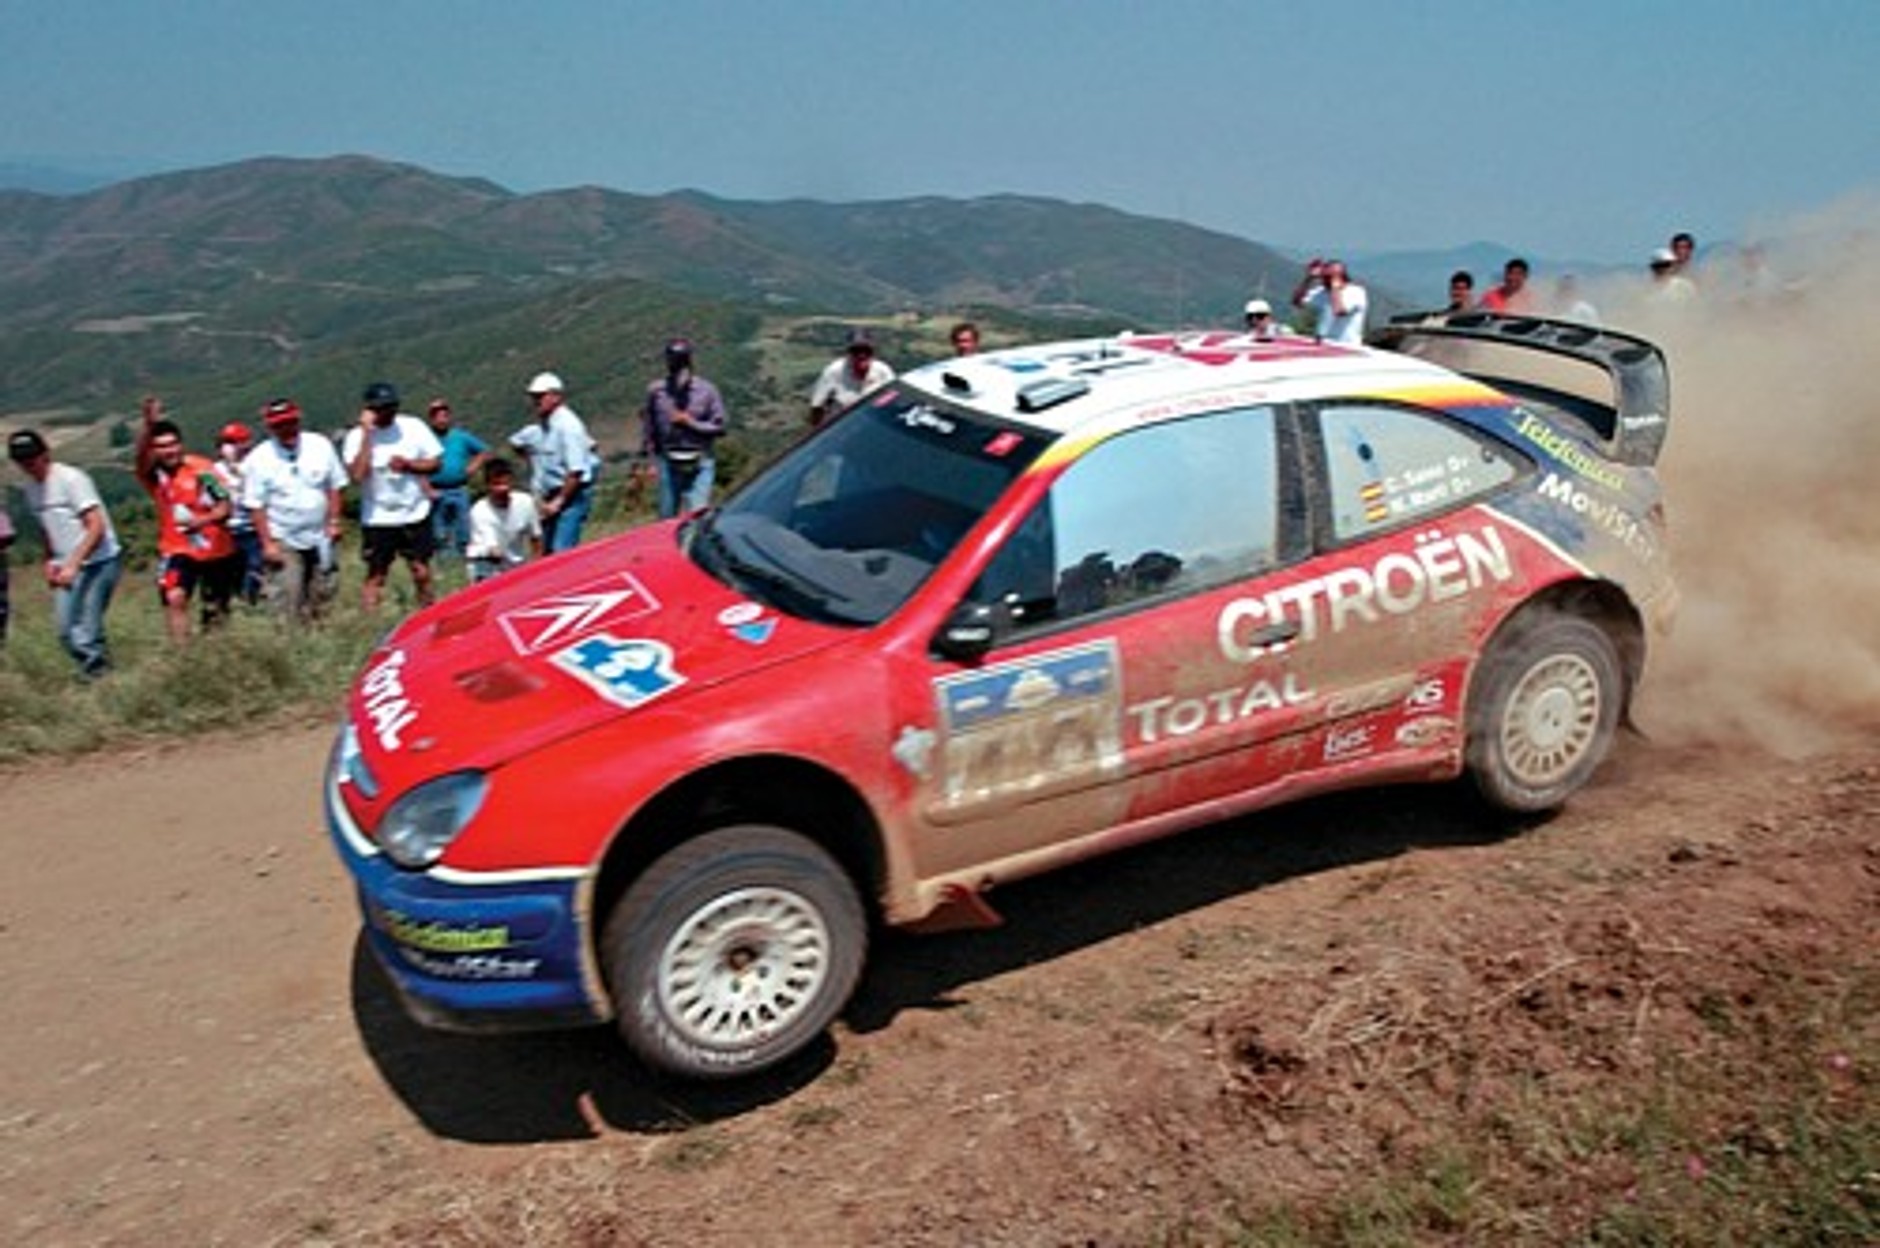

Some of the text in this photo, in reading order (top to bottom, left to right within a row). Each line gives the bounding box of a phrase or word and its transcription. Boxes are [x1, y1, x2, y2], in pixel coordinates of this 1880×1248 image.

[1218, 525, 1512, 664] CITROËN
[361, 649, 419, 752] TOTAL
[1127, 674, 1316, 742] TOTAL
